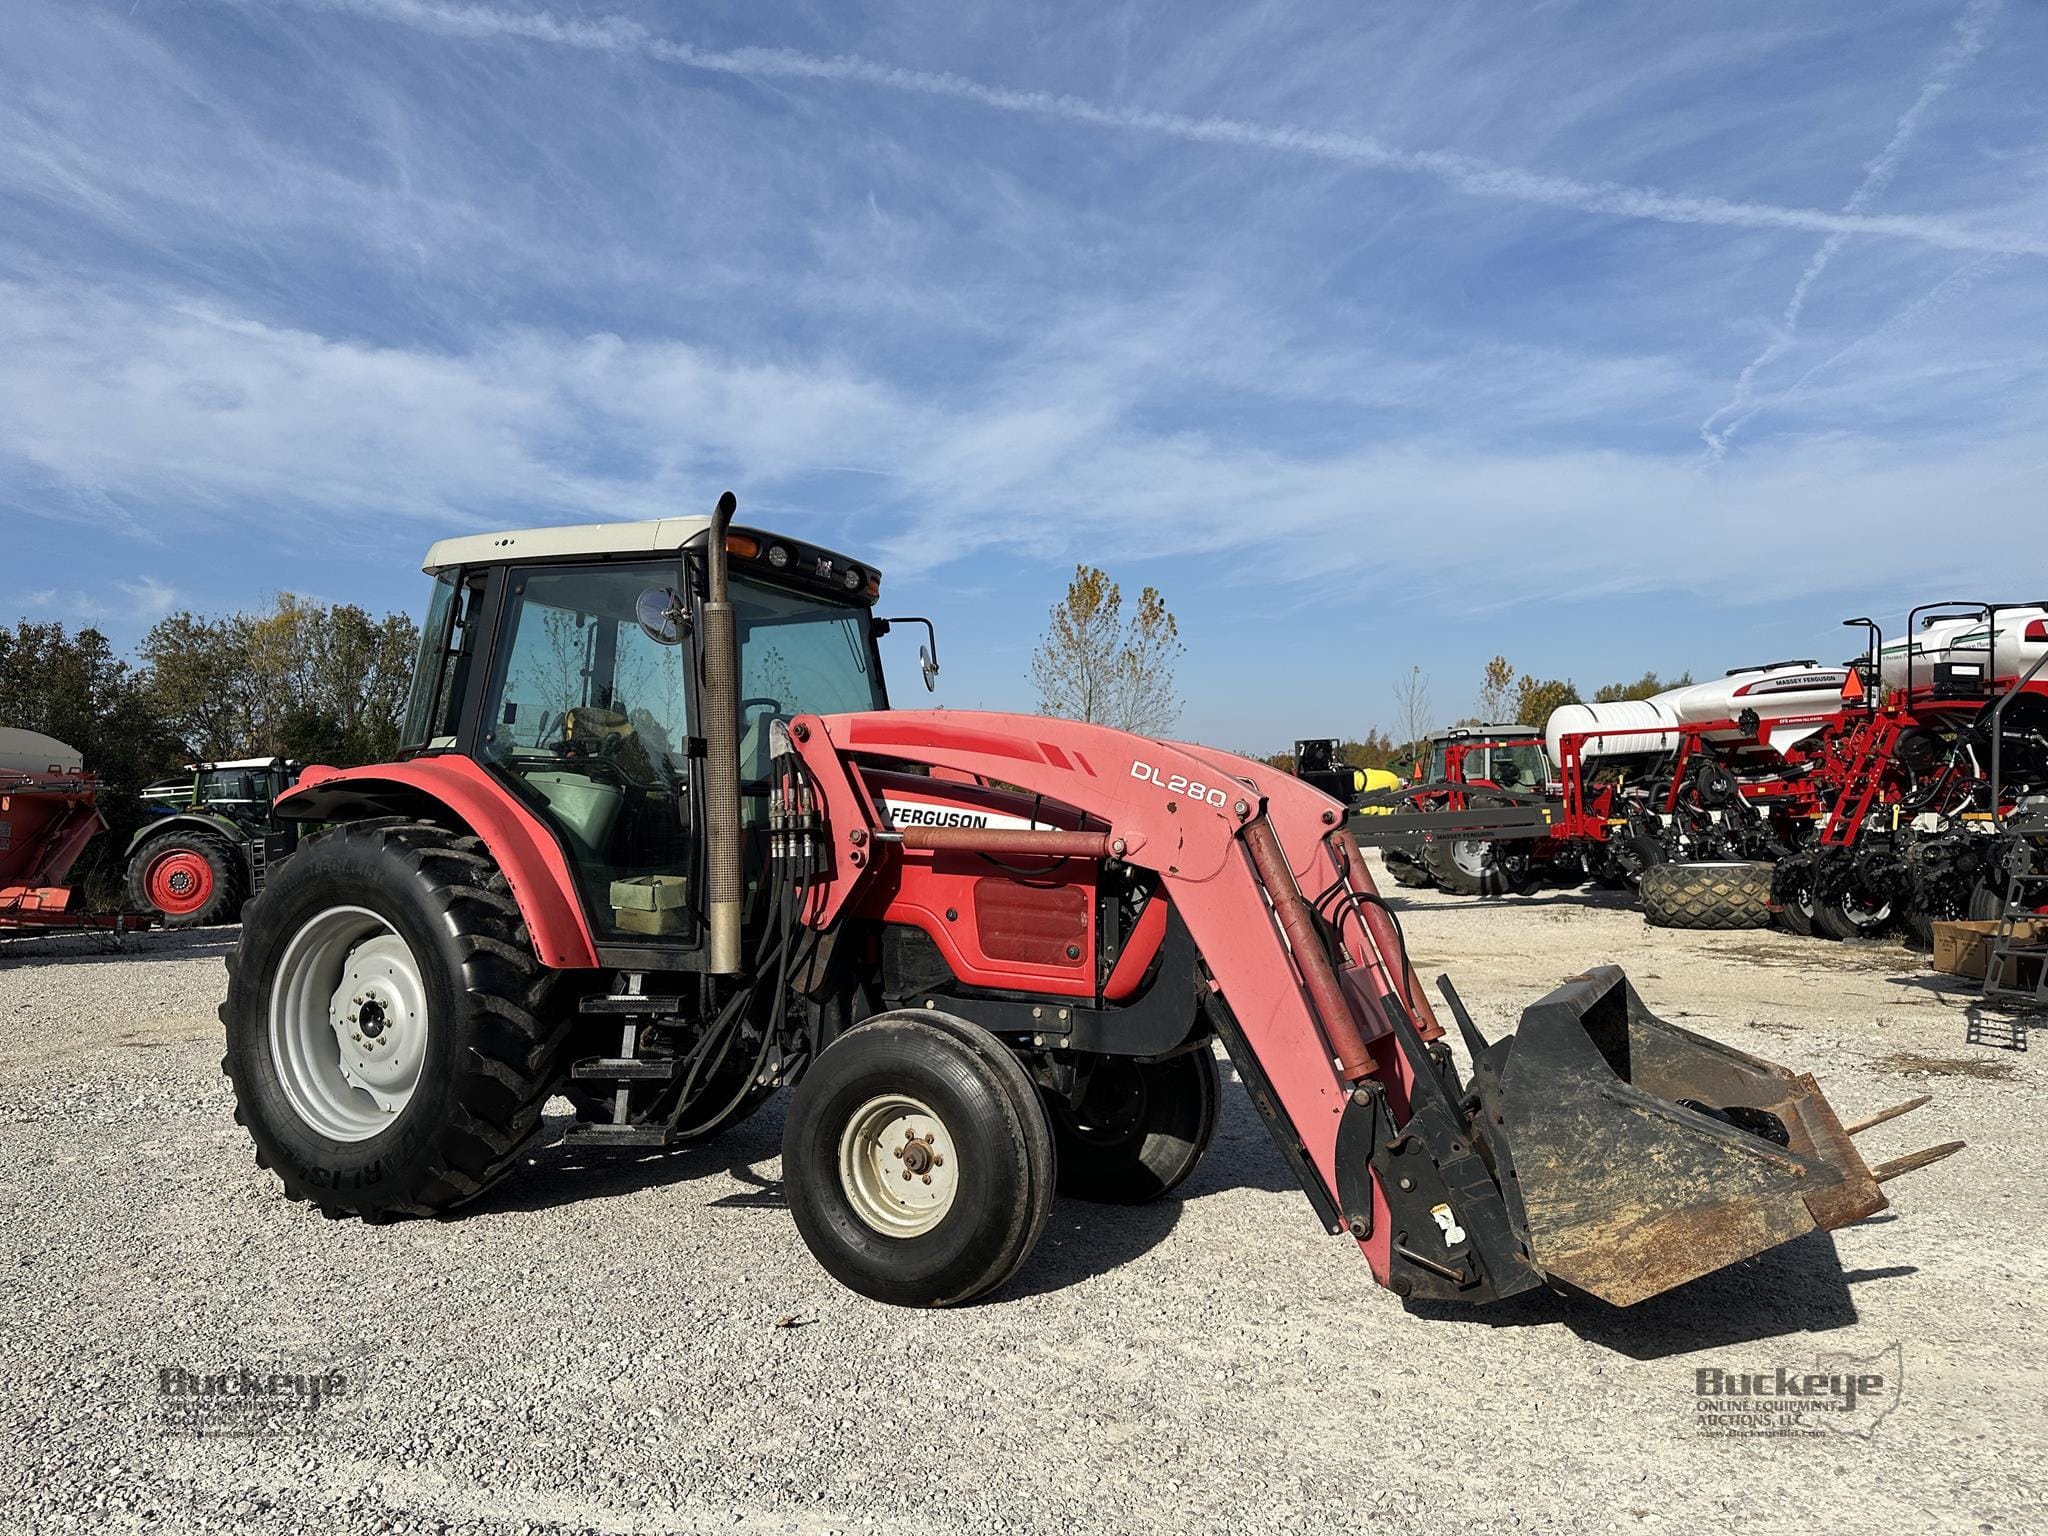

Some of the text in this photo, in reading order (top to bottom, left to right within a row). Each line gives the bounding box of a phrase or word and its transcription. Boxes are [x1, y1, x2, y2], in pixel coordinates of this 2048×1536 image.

[1776, 675, 1836, 686] MASSEY FERGUSON
[1129, 759, 1228, 809] DL280
[889, 807, 988, 829] FERGUSON
[1436, 831, 1495, 840] MASSEY FERGUSON
